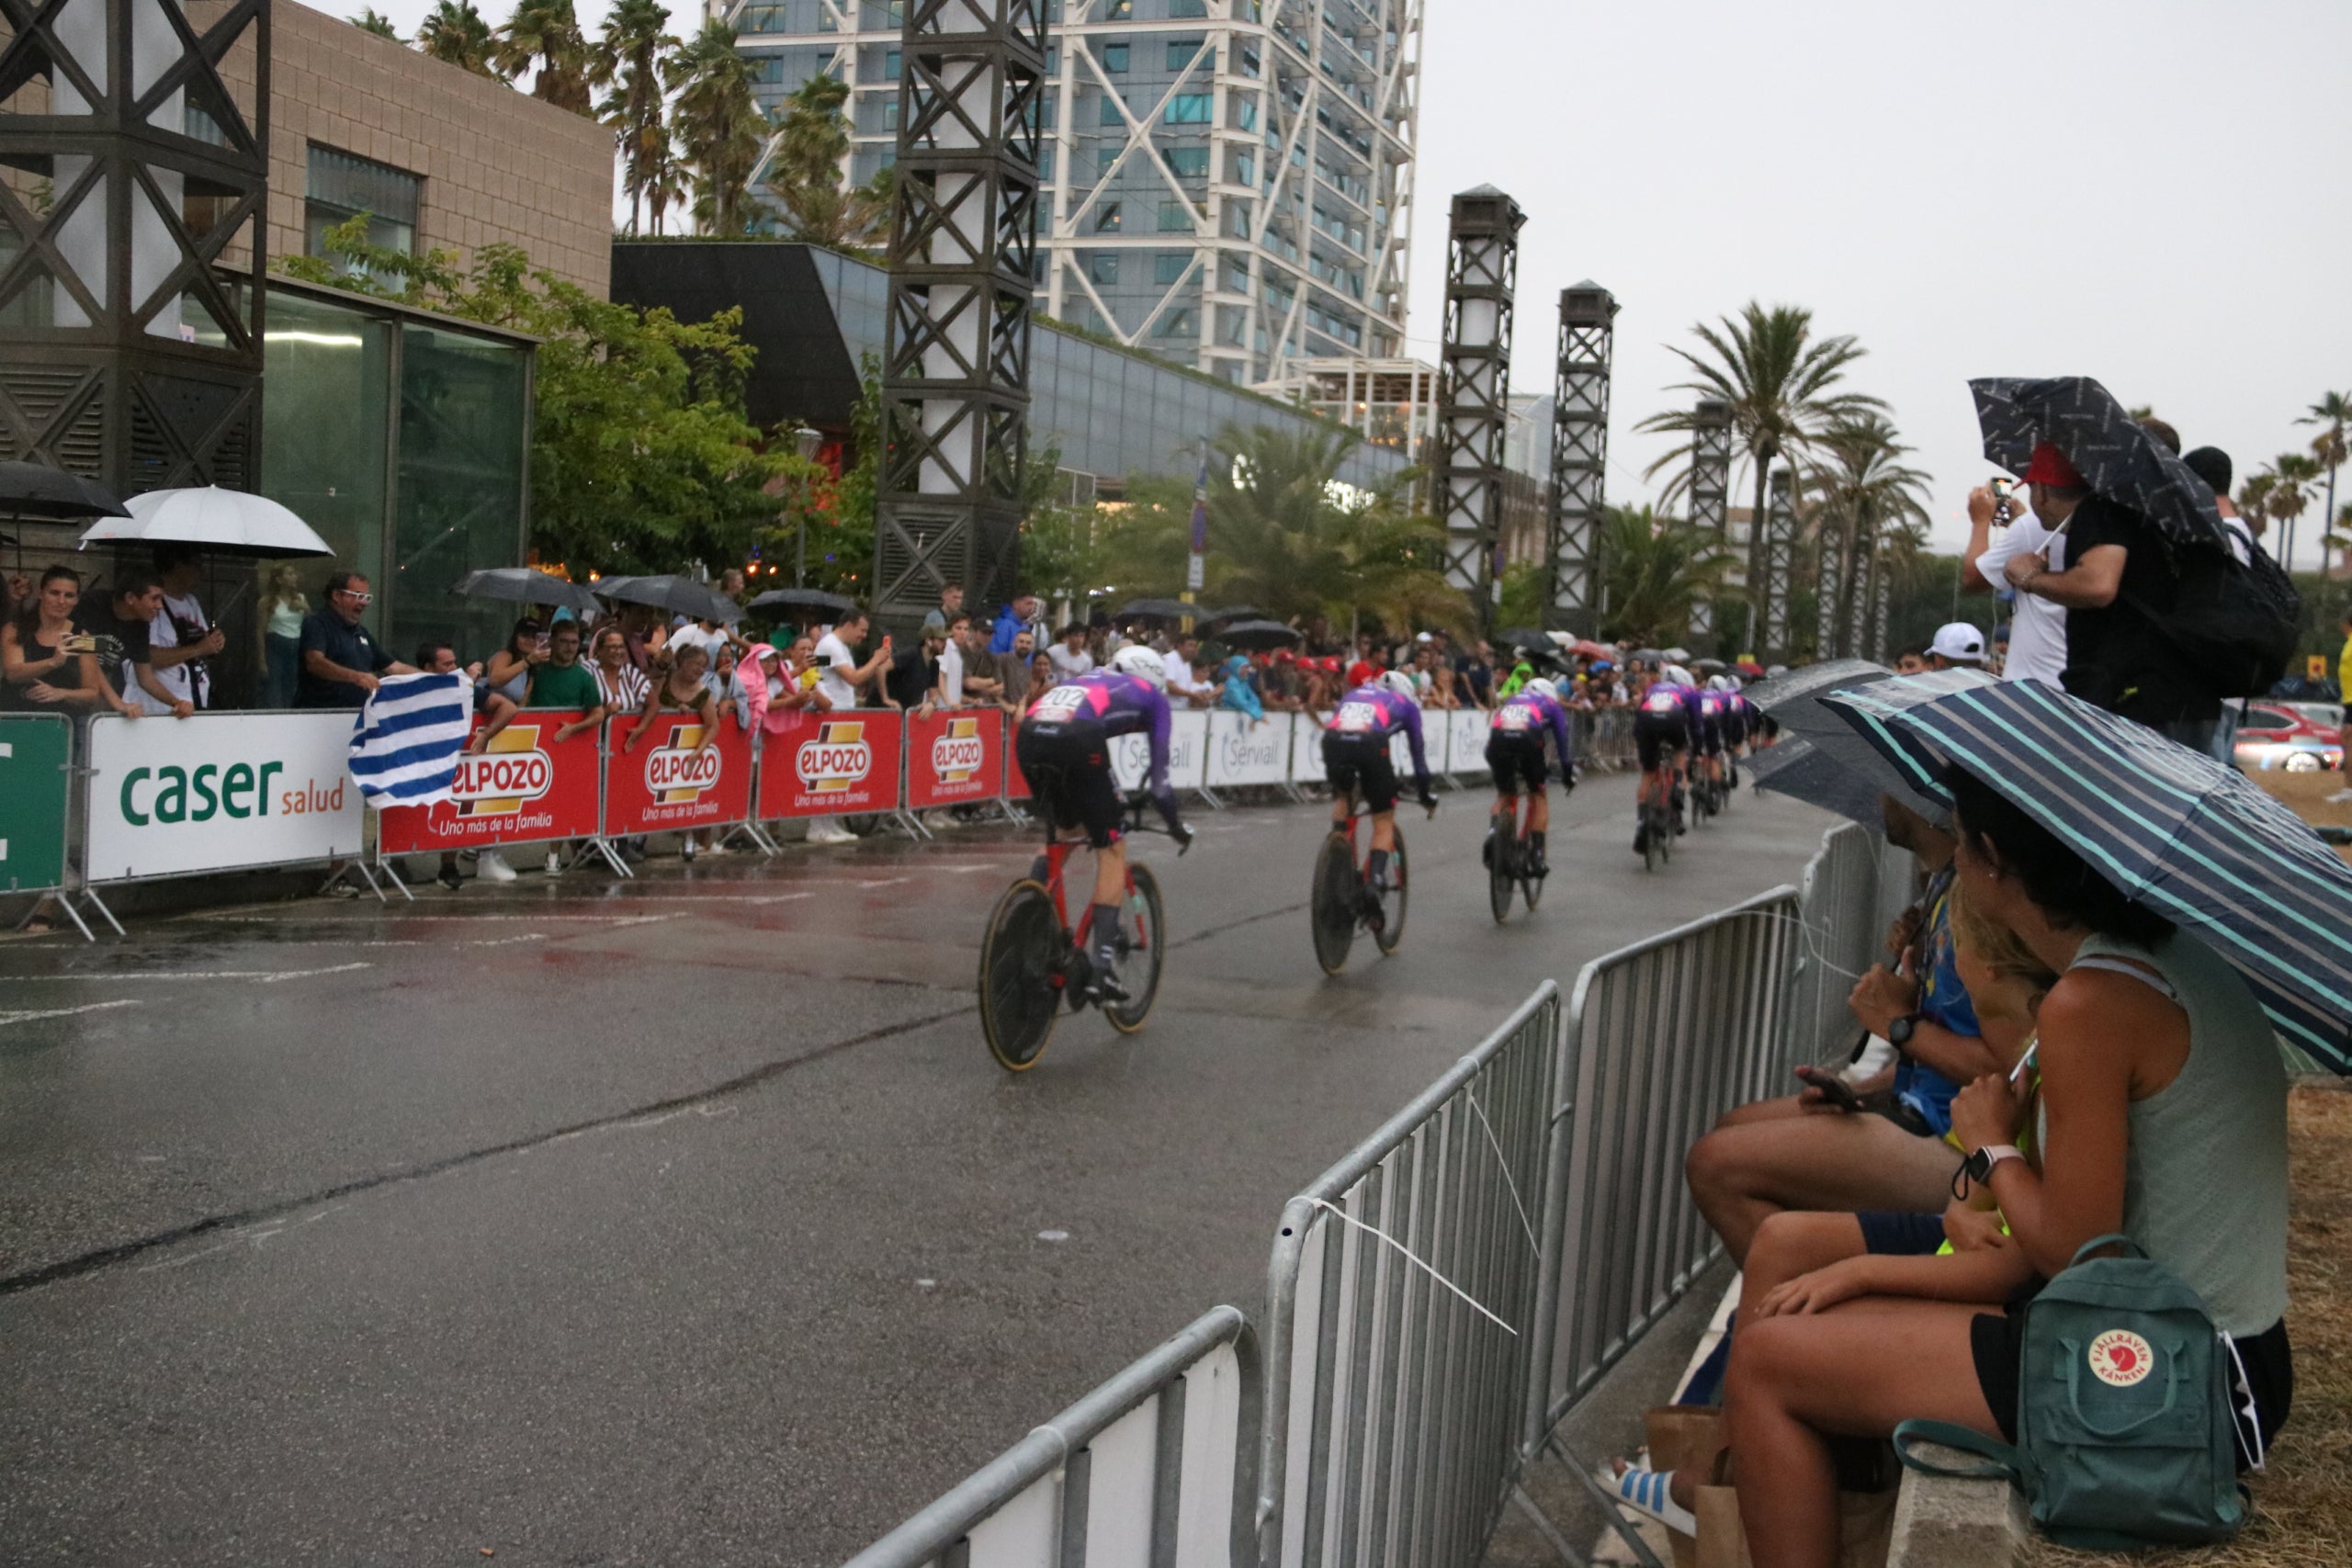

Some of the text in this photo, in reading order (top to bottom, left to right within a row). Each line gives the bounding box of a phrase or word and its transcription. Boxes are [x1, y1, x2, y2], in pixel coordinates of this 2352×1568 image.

[1230, 740, 1278, 765] Serviall
[120, 761, 344, 826] caser salud
[642, 807, 659, 821] Uno
[676, 806, 684, 817] de
[692, 802, 718, 818] familia
[439, 812, 552, 836] Uno más de la familia
